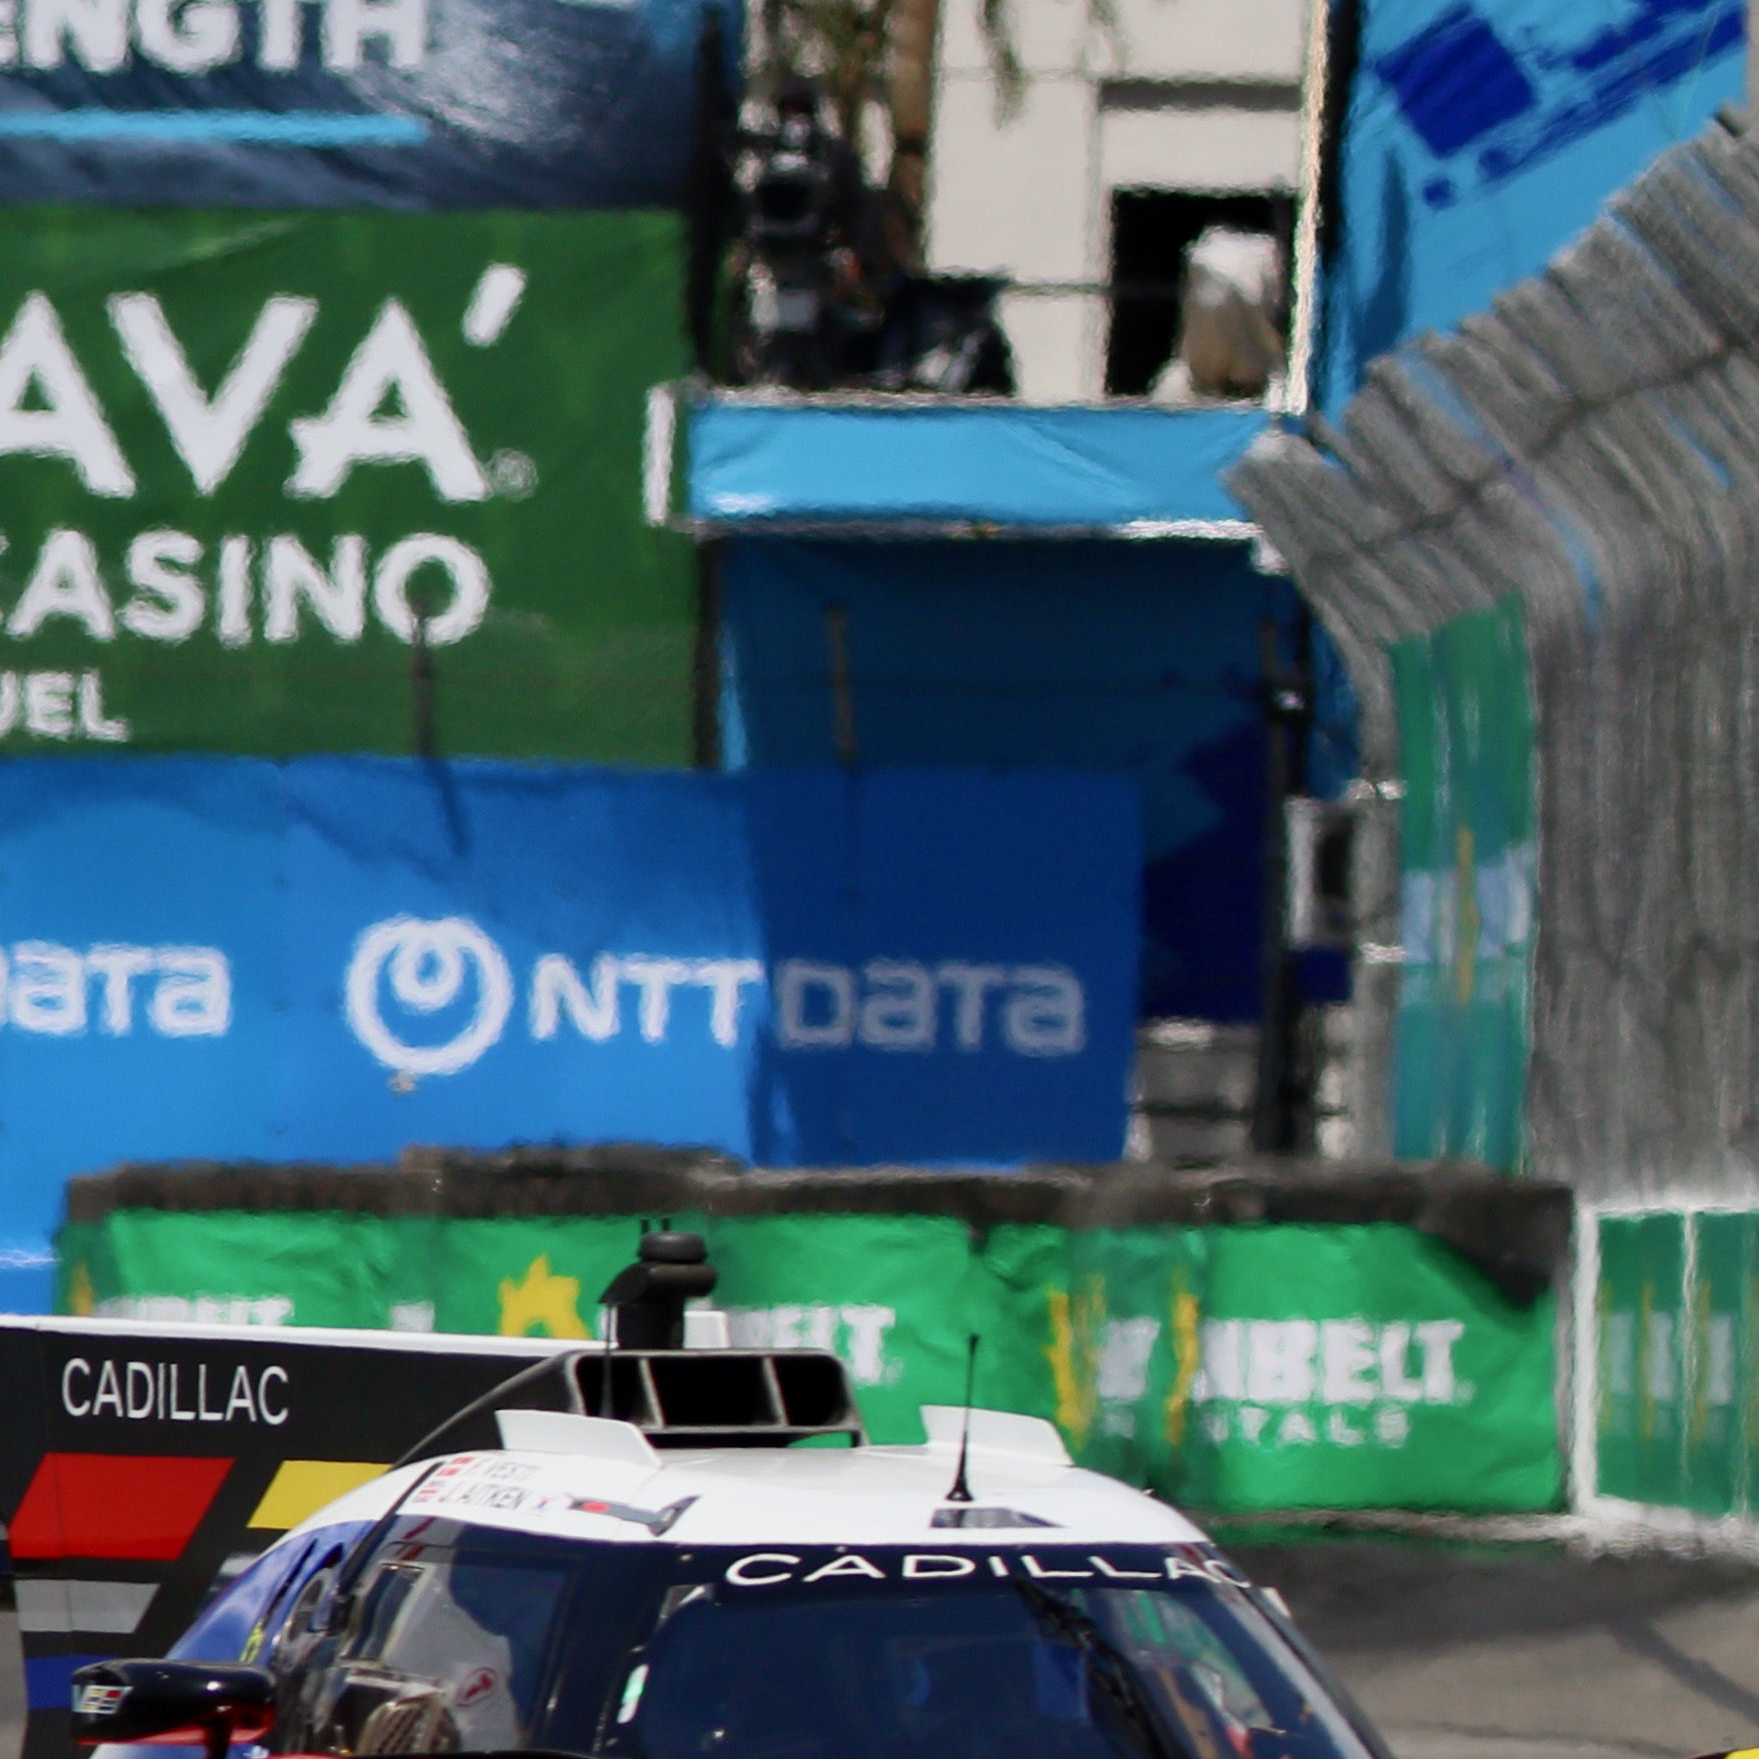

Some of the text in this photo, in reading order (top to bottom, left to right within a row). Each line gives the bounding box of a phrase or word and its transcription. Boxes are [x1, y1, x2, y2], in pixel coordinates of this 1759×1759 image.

[527, 950, 767, 1050] NTT
[61, 1357, 289, 1425] CADILLAC
[725, 1551, 1251, 1588] CADILLAC
